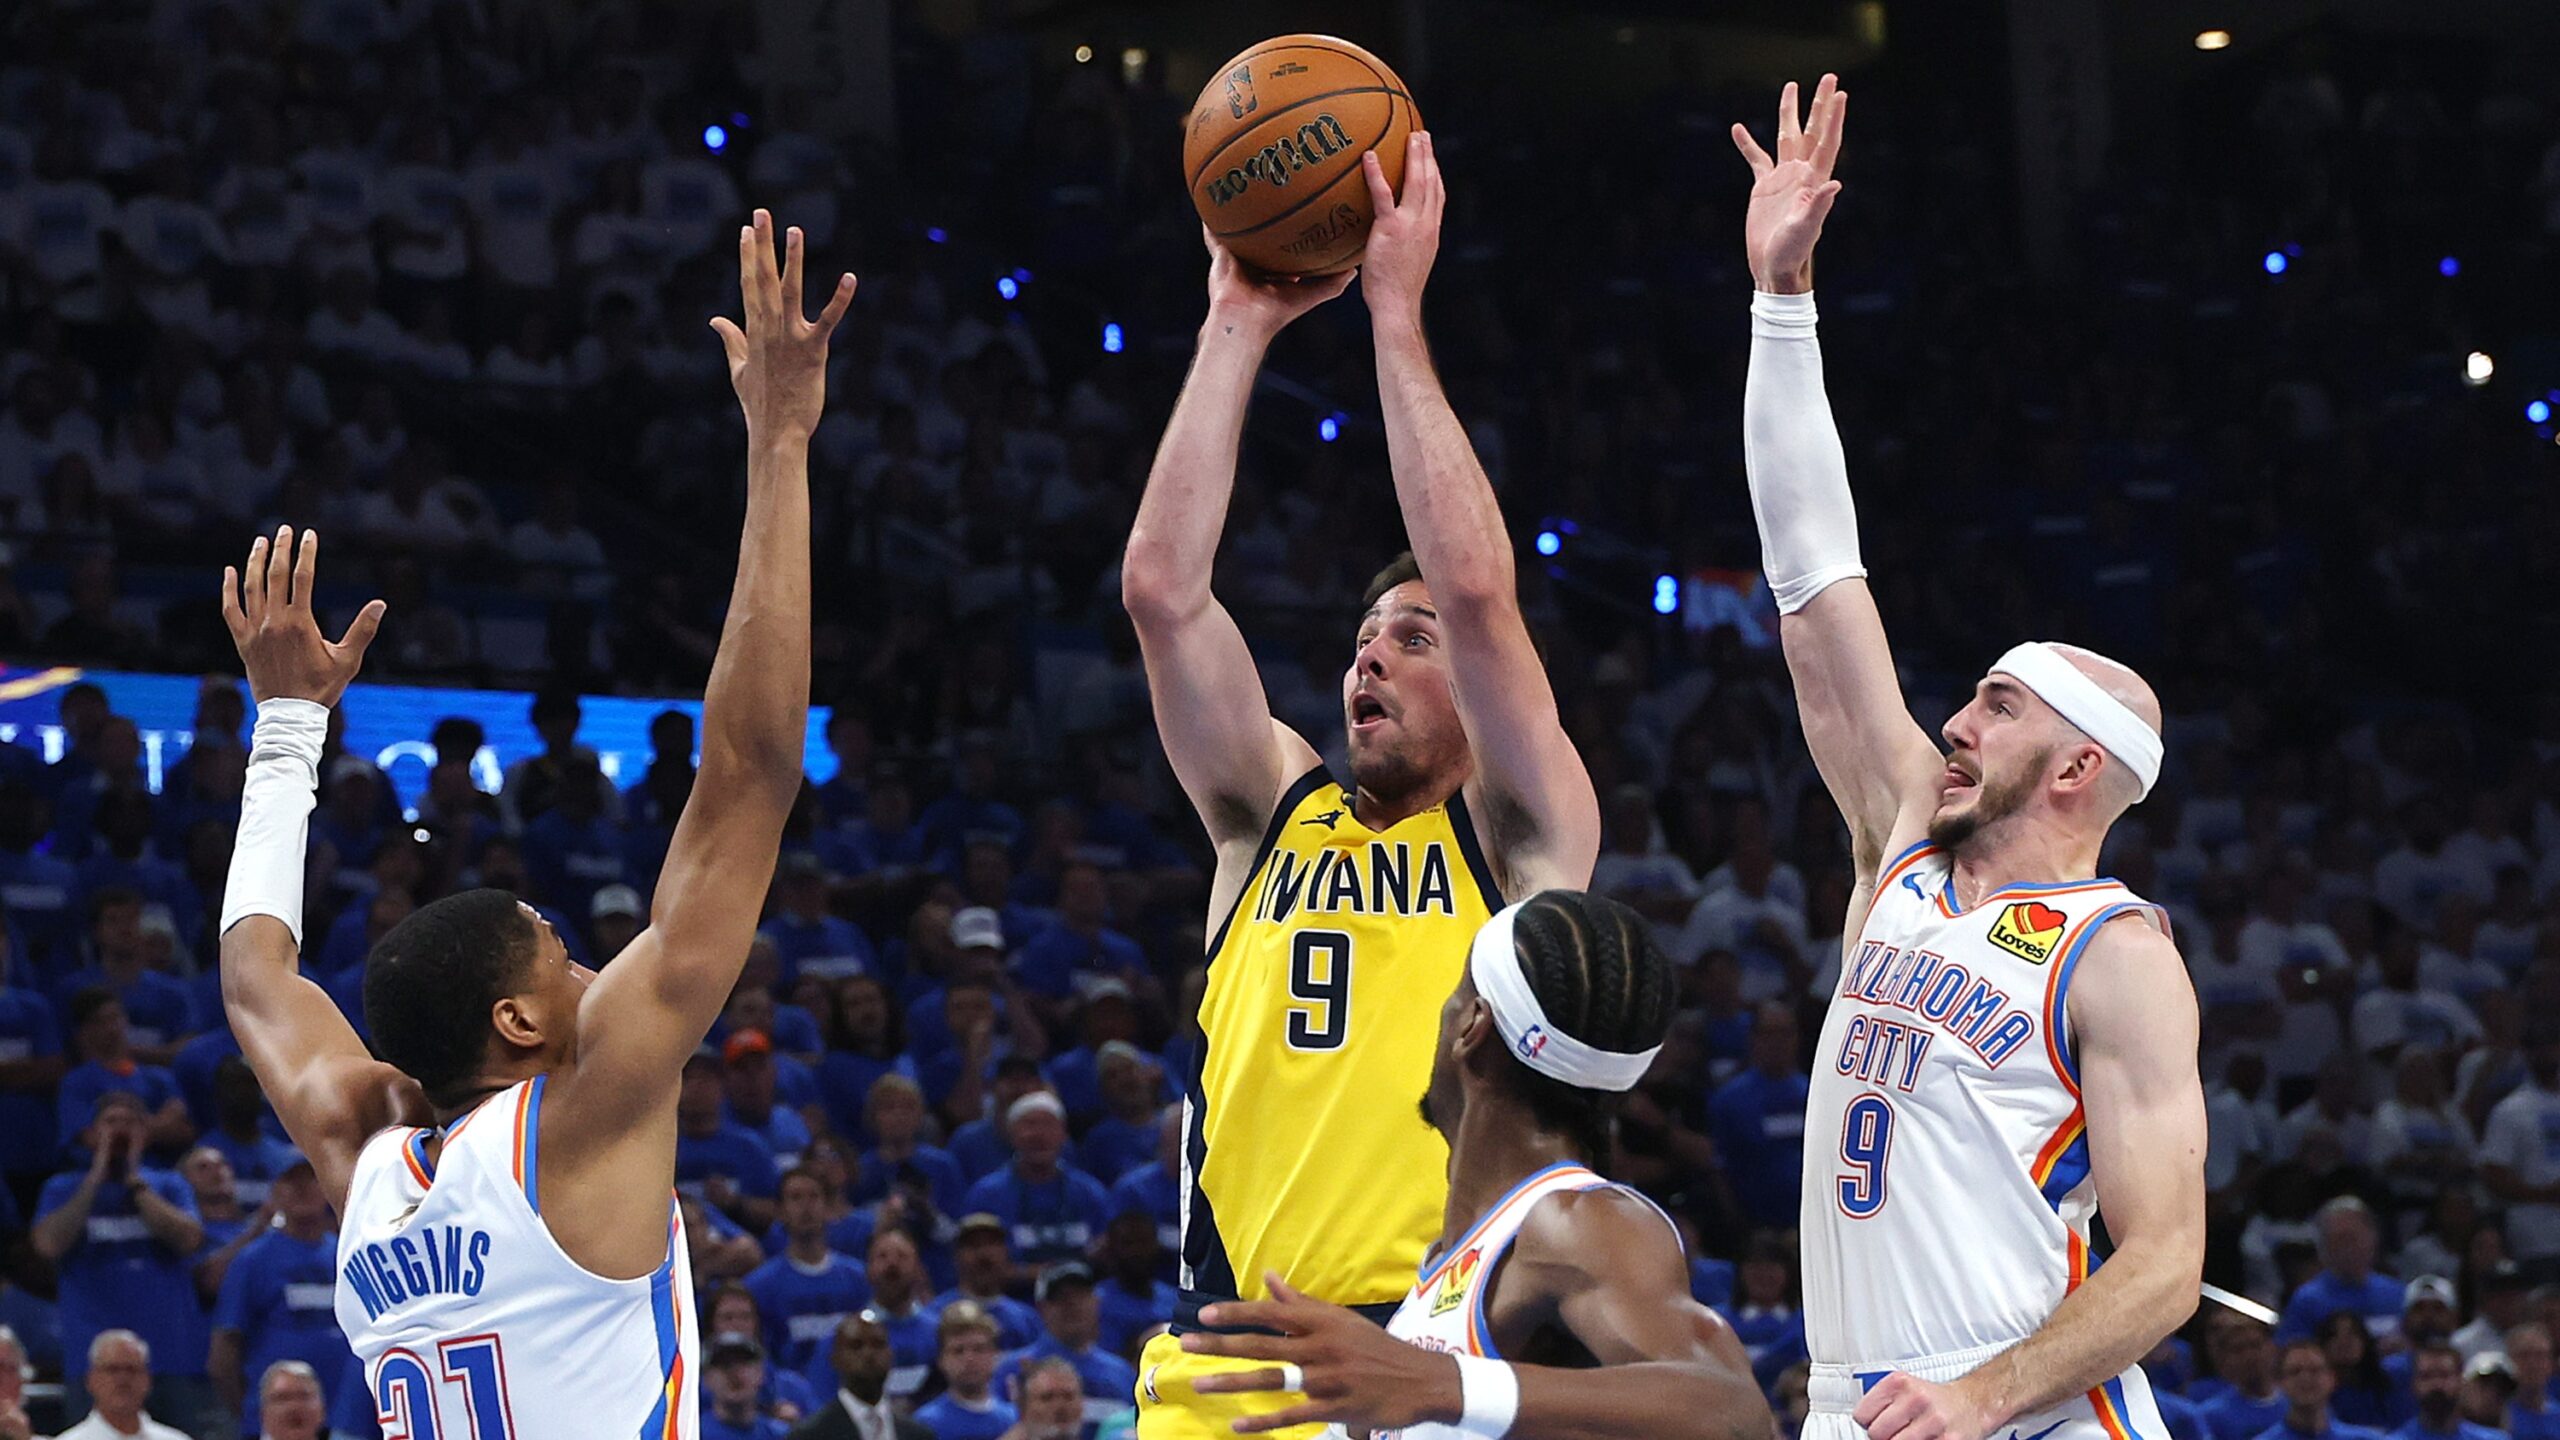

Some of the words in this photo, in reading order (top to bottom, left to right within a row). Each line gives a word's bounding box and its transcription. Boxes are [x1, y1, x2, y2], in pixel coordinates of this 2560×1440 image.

[1206, 112, 1354, 208] Wilson
[1254, 841, 1456, 924] INIANA
[1285, 928, 1353, 1052] 9
[1841, 940, 2035, 1070] KLAHOMA
[1836, 1014, 1934, 1092] CITY
[1836, 1092, 1895, 1219] 9
[343, 1225, 491, 1323] WIGGINS
